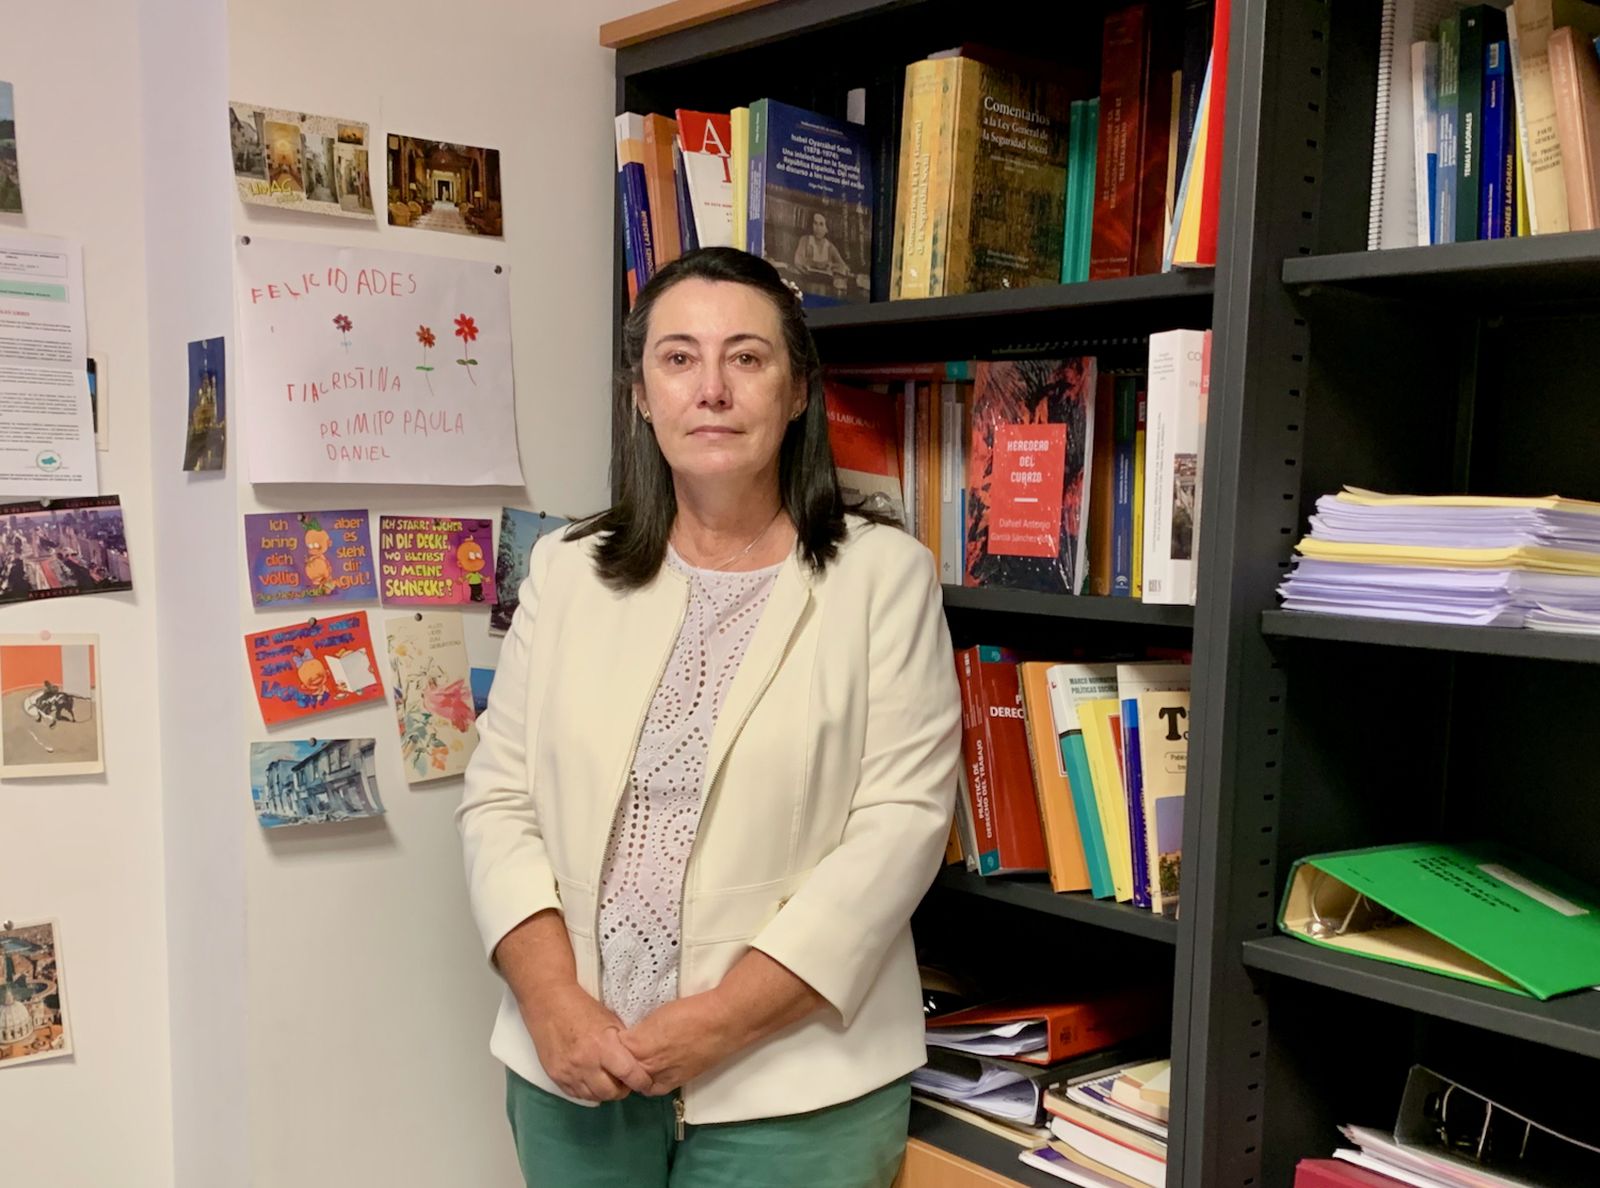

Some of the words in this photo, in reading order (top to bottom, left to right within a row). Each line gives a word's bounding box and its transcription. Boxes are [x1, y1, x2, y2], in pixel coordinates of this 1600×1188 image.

[984, 96, 1050, 126] Comentarios
[1011, 122, 1039, 138] General
[991, 132, 1026, 149] Seguridad
[1505, 154, 1513, 203] LABORUM
[251, 267, 417, 304] FELICIDADES
[403, 409, 465, 437] PAULA
[326, 444, 391, 462] DANIEL
[1007, 440, 1049, 452] HEREDERO
[1019, 456, 1035, 467] DEL
[334, 517, 364, 529] aber
[397, 519, 430, 531] STARRE
[261, 534, 298, 550] bring
[343, 531, 359, 542] es
[382, 533, 394, 550] IN
[396, 533, 414, 550] DIE
[336, 545, 366, 558] steht
[384, 552, 401, 561] WO
[404, 552, 445, 562] BLEIBST
[265, 553, 293, 567] dich
[343, 559, 362, 572] dir
[382, 565, 397, 575] DU
[401, 565, 442, 577] MEINE
[385, 578, 453, 598] SCHNECKE?
[976, 739, 985, 778] TRABAJO
[983, 797, 992, 838] DERECHO
